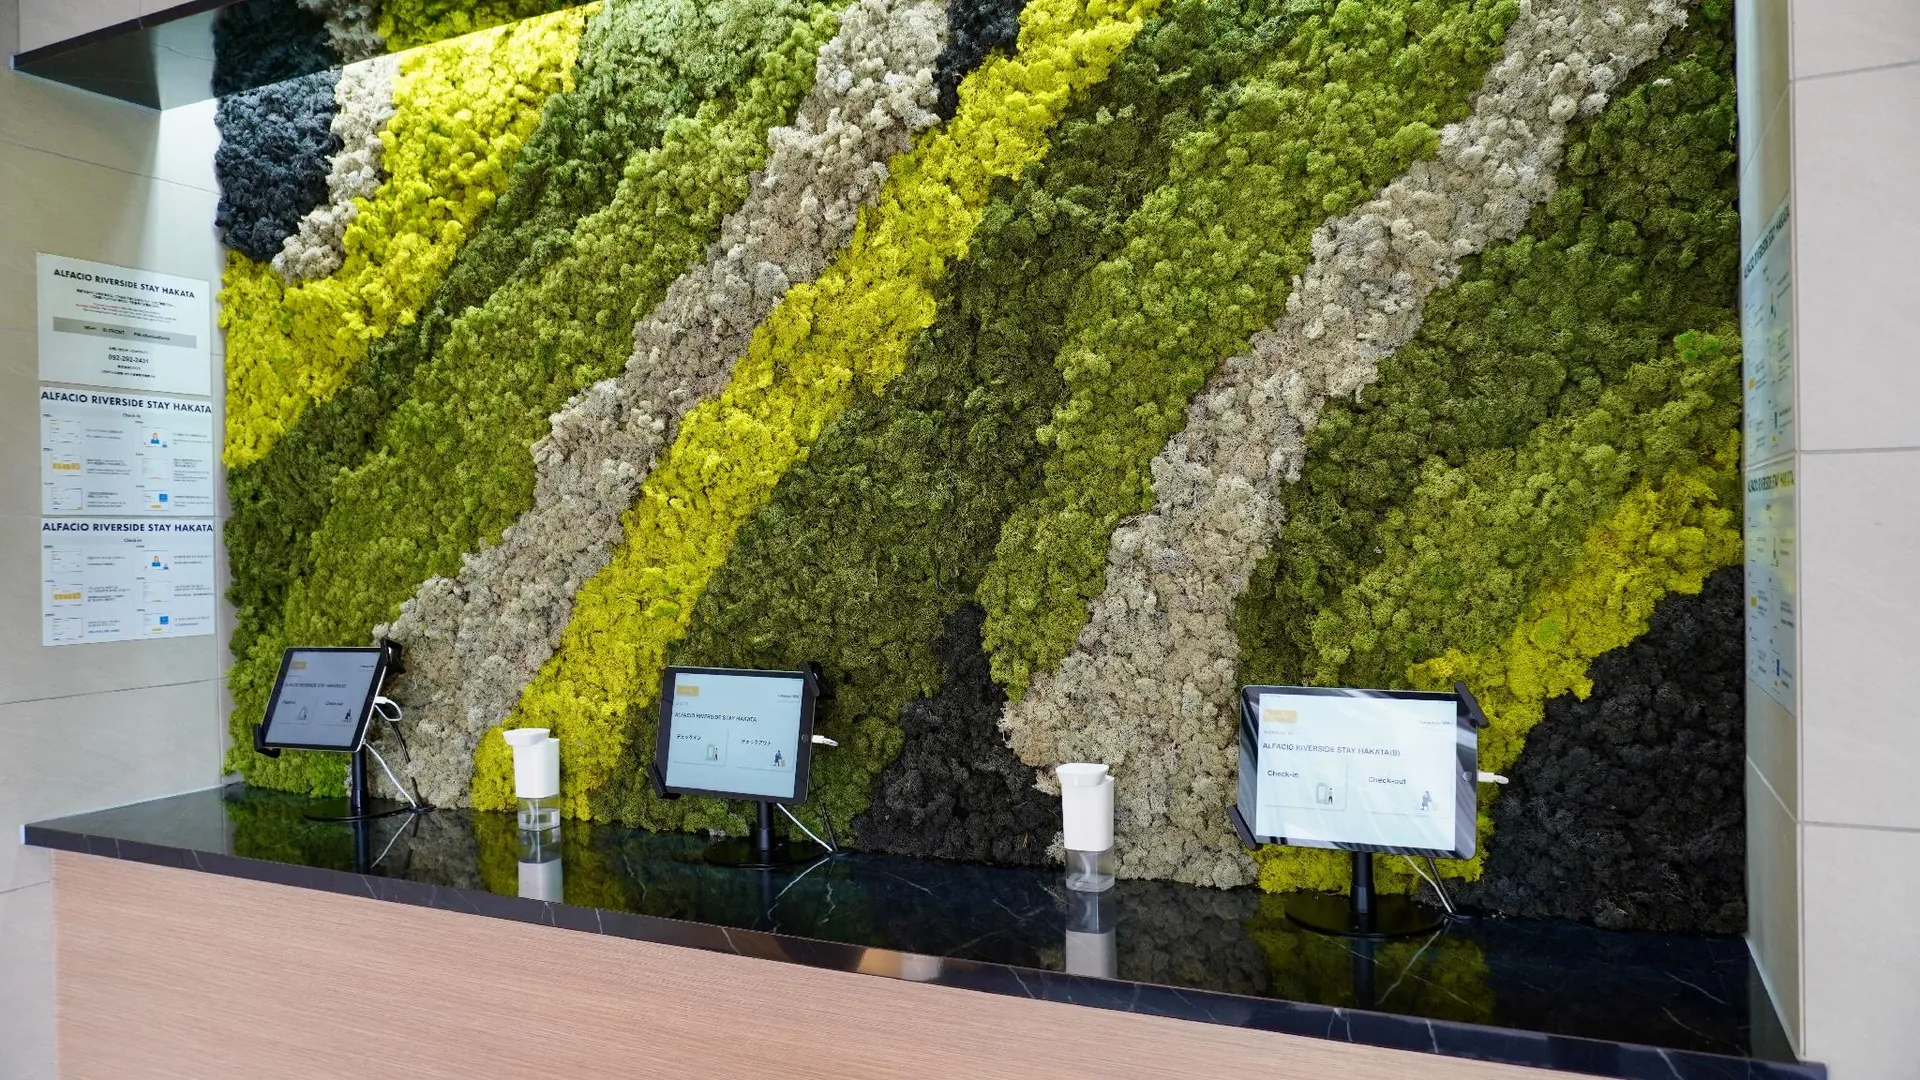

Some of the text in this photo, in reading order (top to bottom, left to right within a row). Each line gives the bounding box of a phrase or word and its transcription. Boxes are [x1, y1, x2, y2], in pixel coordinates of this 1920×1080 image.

[53, 269, 92, 282] ALFACIO
[95, 275, 138, 289] RIVERSIDE
[140, 283, 160, 292] STAY
[162, 287, 195, 299] HAKATA
[41, 391, 212, 414] ALFACIO RIVERSIDE STAY HAKATA
[42, 523, 213, 532] ALFACIO RIVERSIDE STAY HAKATA
[1262, 742, 1294, 751] ALFACIO
[1295, 744, 1335, 753] RIVERSIDE
[1336, 746, 1357, 754] STAY
[1267, 770, 1299, 778] Check-in
[1368, 777, 1407, 785] Check-out
